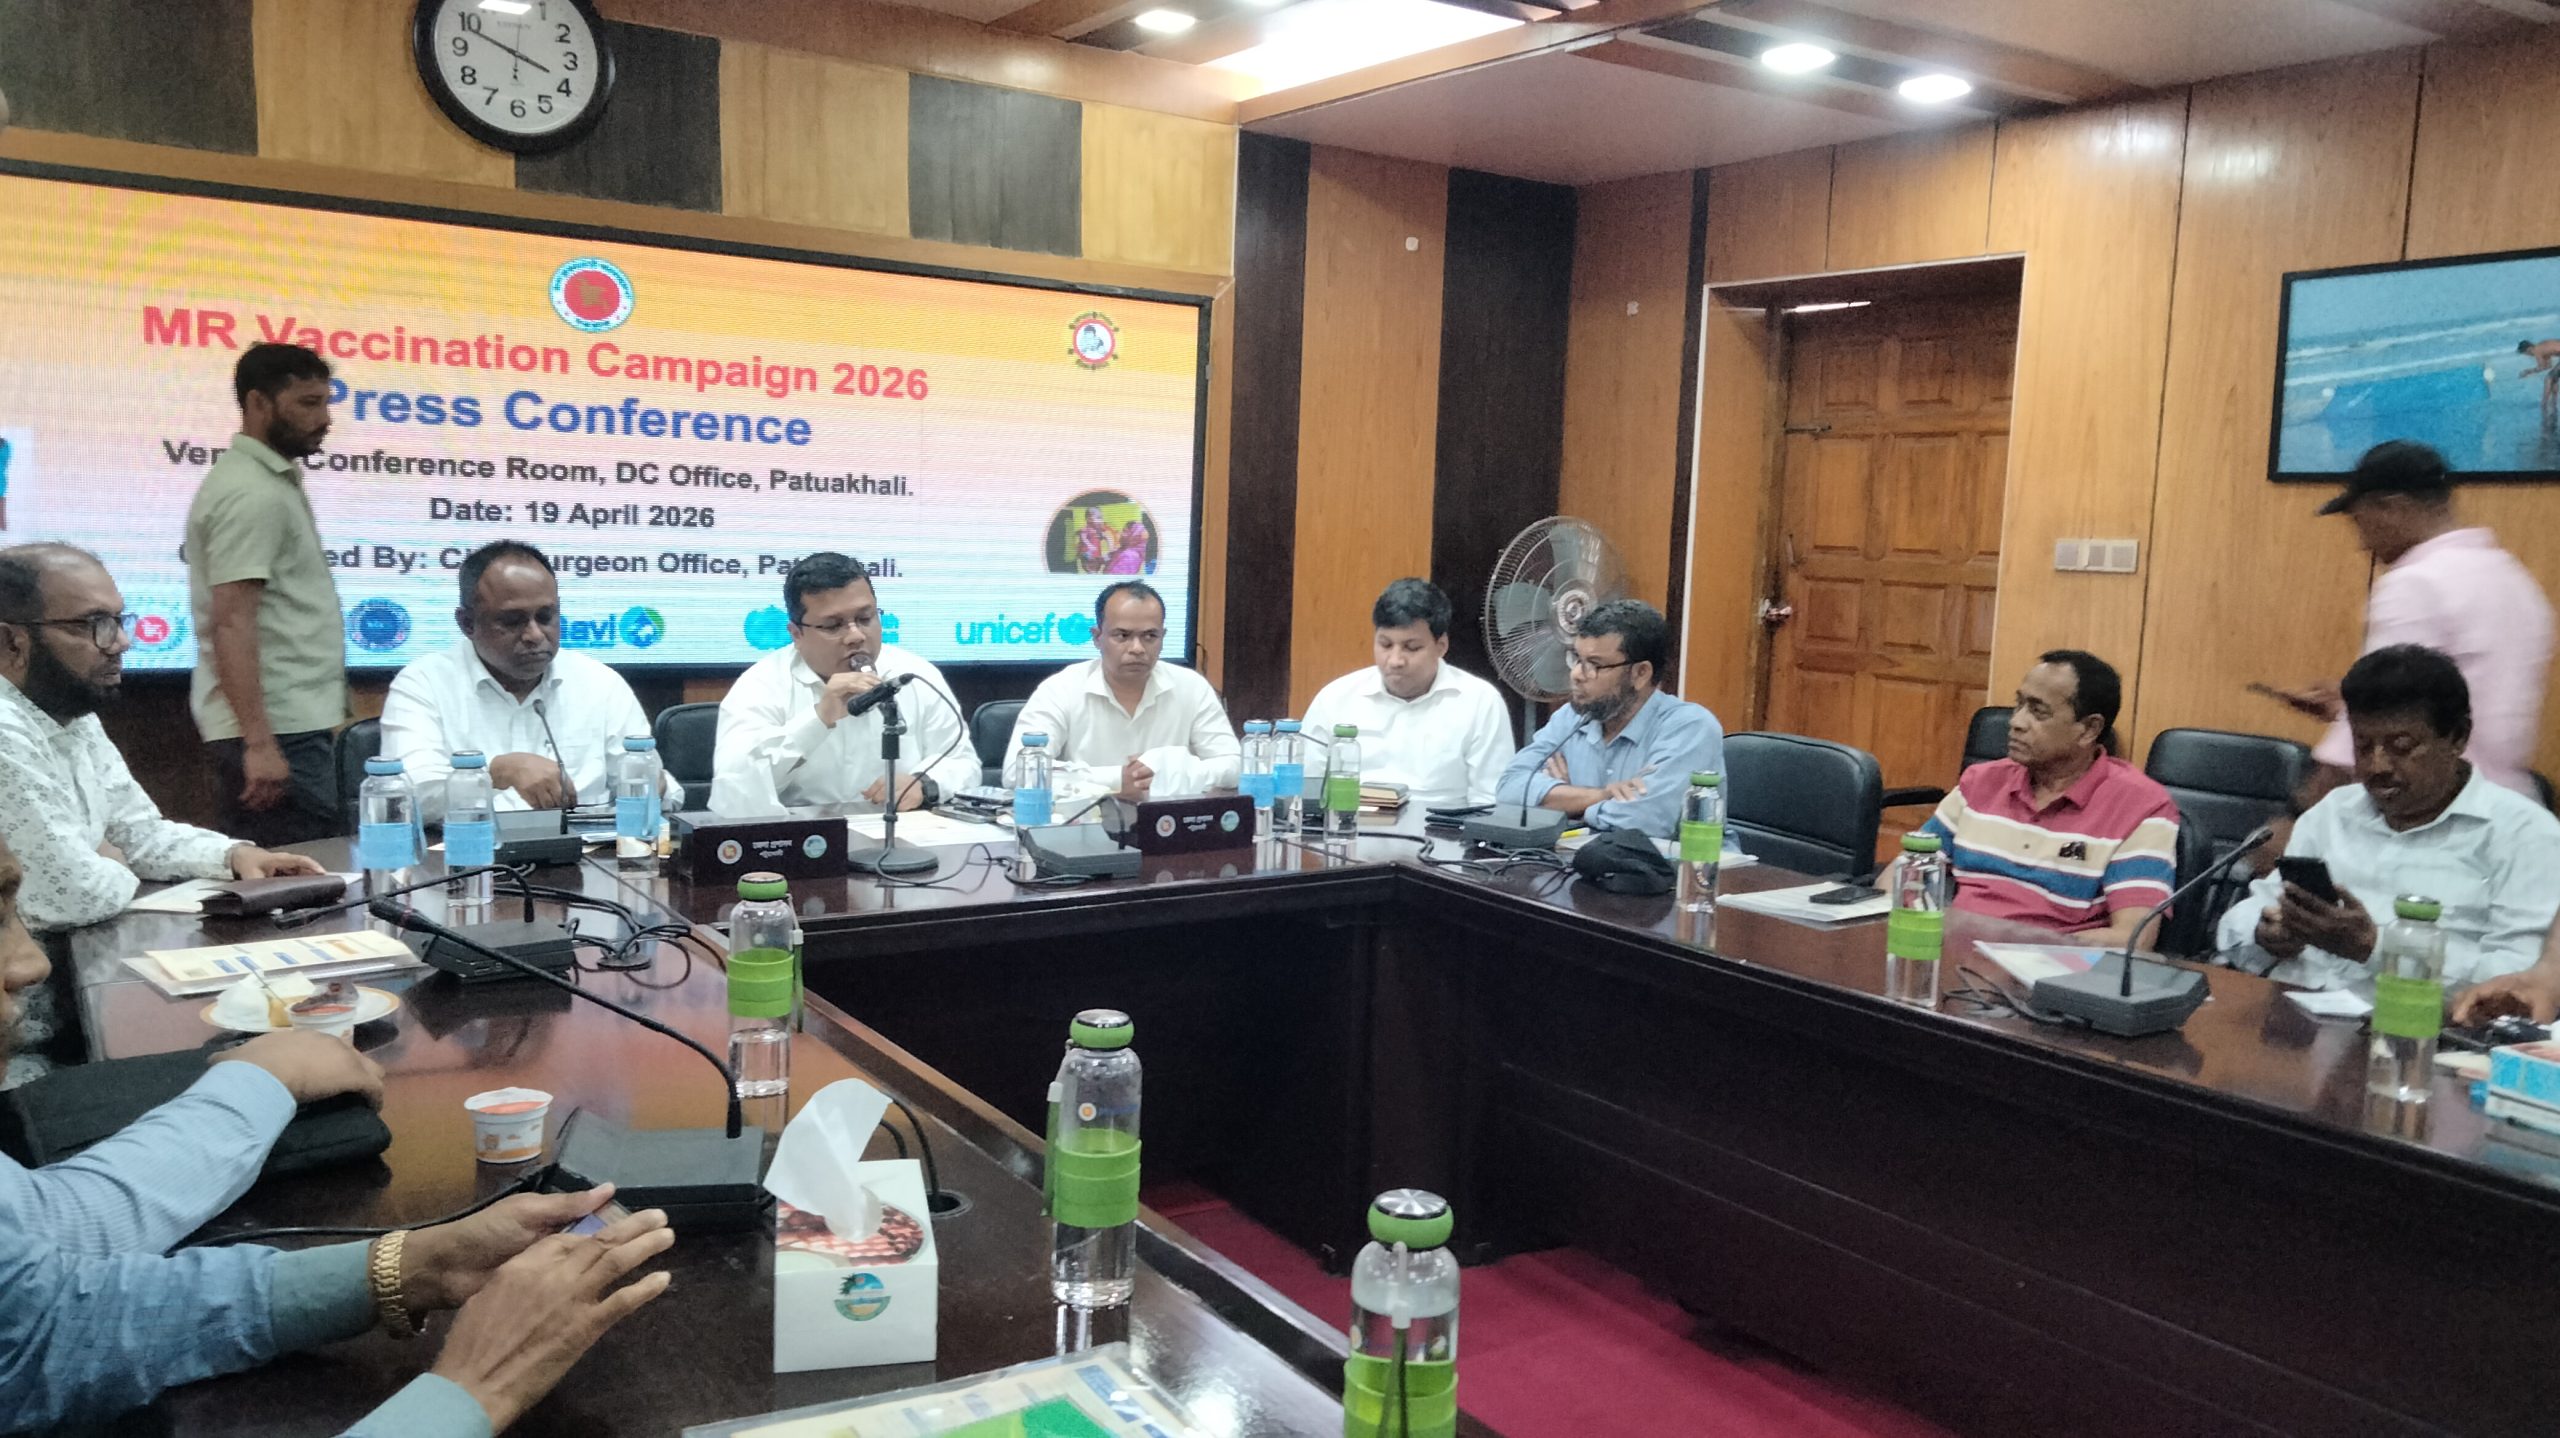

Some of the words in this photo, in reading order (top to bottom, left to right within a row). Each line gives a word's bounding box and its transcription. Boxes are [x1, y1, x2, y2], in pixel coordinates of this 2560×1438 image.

[459, 12, 481, 32] 10
[556, 24, 571, 43] 2
[452, 37, 468, 56] 9
[563, 52, 578, 71] 3
[460, 66, 477, 85] 8
[482, 86, 499, 105] 7
[557, 78, 572, 97] 4
[510, 100, 526, 118] 6
[537, 95, 553, 114] 5
[142, 306, 237, 349] MR
[256, 314, 570, 374] Vaccination
[588, 342, 818, 398] Campaign
[833, 363, 928, 401] 2026
[505, 390, 812, 446] Conference
[302, 449, 495, 479] Conference
[506, 457, 605, 486] Room,
[617, 463, 659, 484] DC
[669, 465, 760, 492] Office,
[770, 470, 914, 497] Patuakhali.
[430, 497, 512, 522] Date:
[525, 502, 558, 523] 19
[568, 503, 639, 529] April
[649, 505, 714, 528] 2026
[374, 546, 426, 575] By:
[549, 555, 648, 577] urgeon
[658, 553, 748, 578] Office,
[955, 613, 1056, 645] unicef
